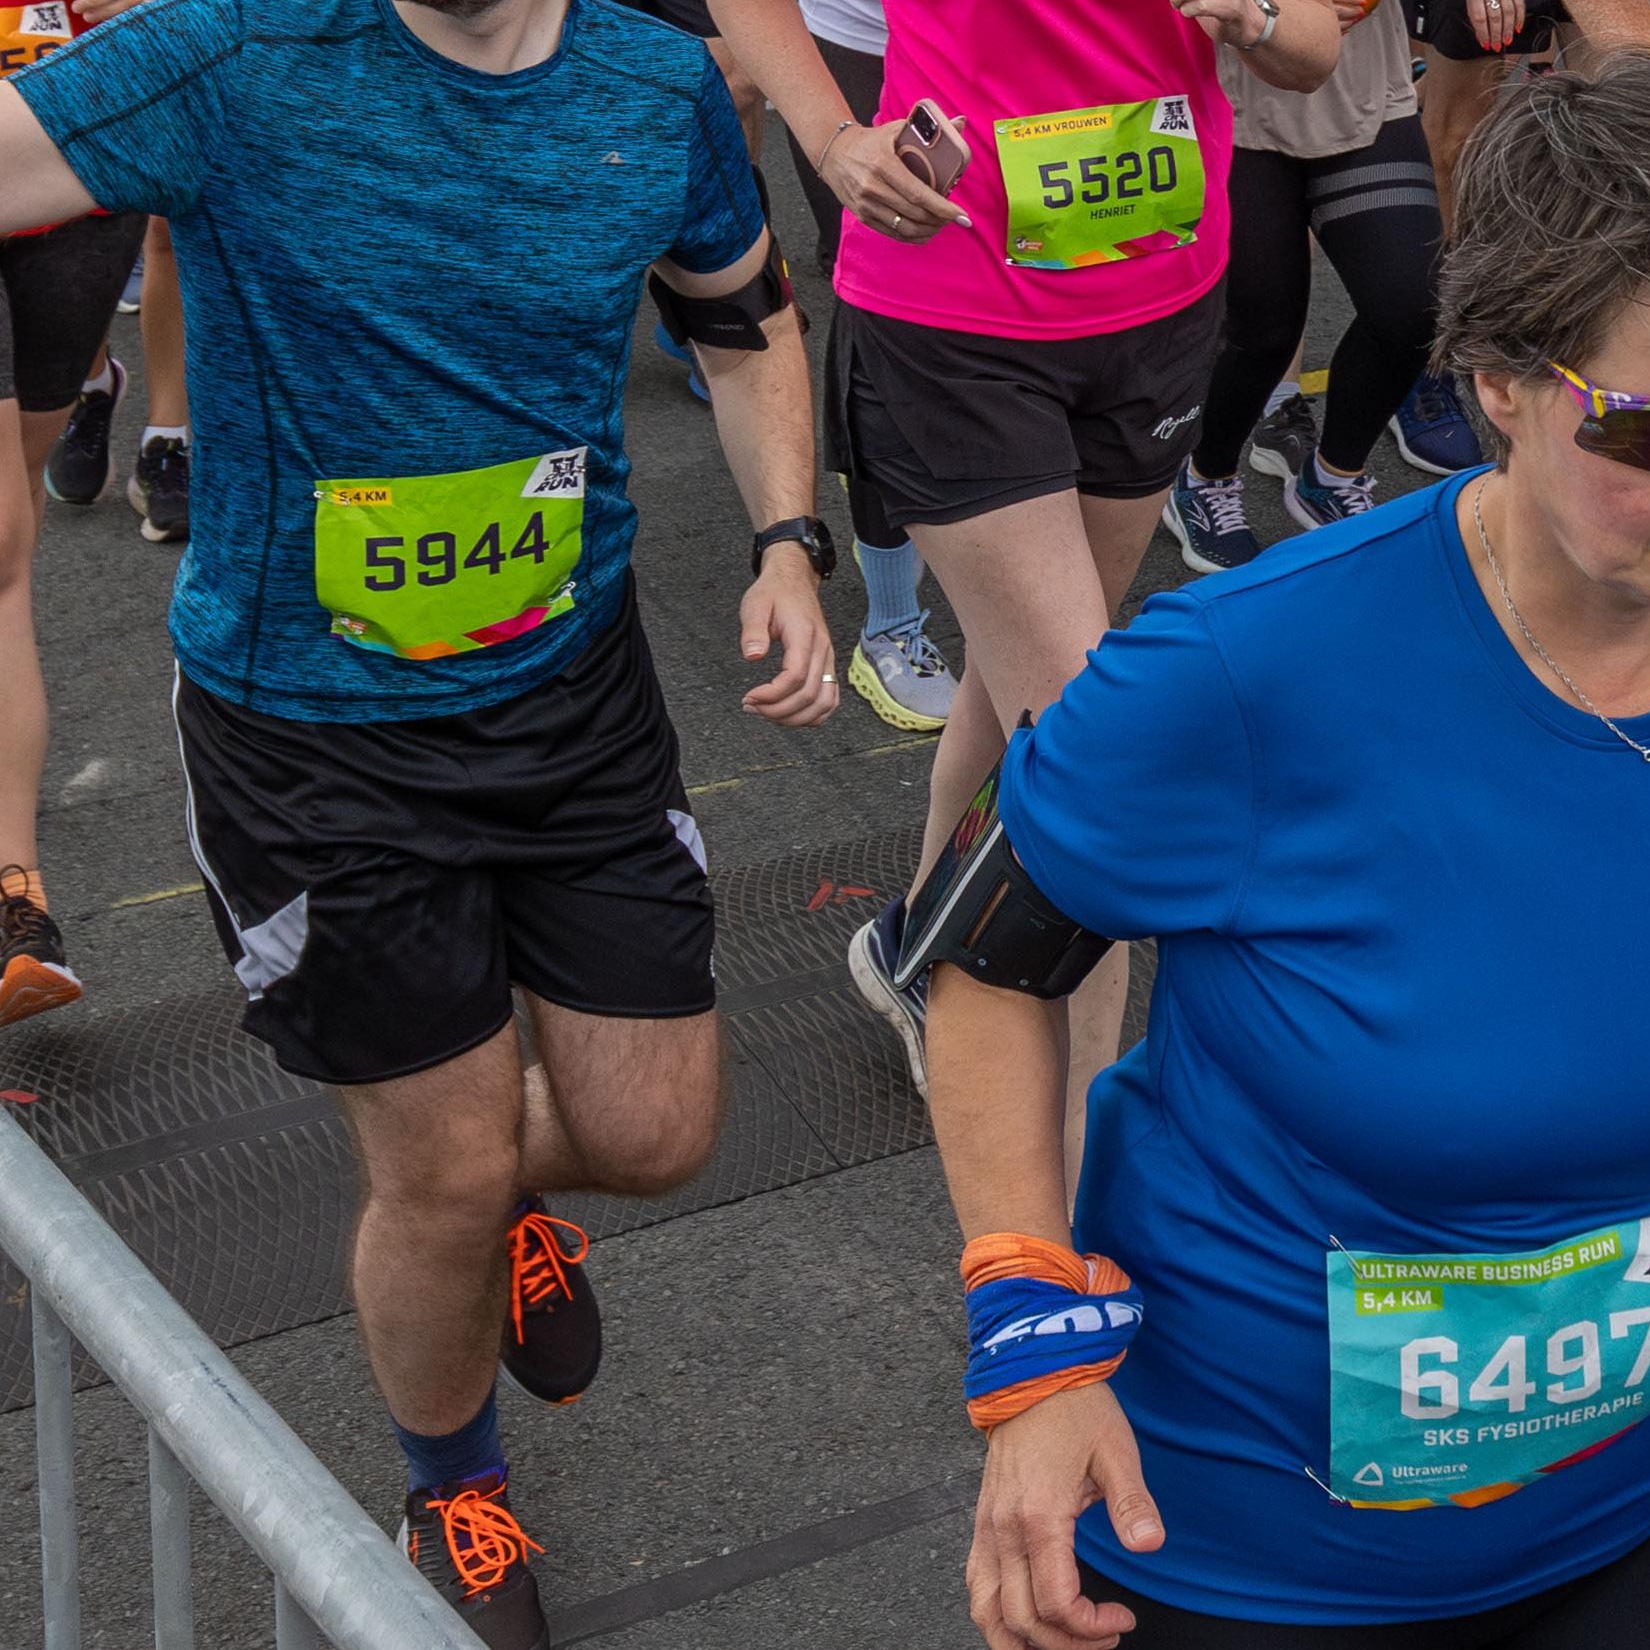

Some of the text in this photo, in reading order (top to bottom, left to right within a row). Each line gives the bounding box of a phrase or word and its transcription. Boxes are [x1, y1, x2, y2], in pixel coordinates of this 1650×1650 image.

[1013, 116, 1108, 138] 5,4 KM VROUWEN
[1159, 119, 1190, 131] RUN
[1038, 145, 1178, 209] 5520
[1090, 204, 1137, 221] HENRIET
[533, 474, 579, 494] RUN
[365, 490, 388, 502] KM
[364, 511, 550, 591] 5944
[1362, 1238, 1617, 1282] ULTRAWARE BUSINESS RUN
[1362, 1289, 1433, 1311] 5,4 KM
[1422, 1390, 1646, 1447] SKS FYSIOTHERAPIE
[1392, 1460, 1469, 1479] Ultraware
